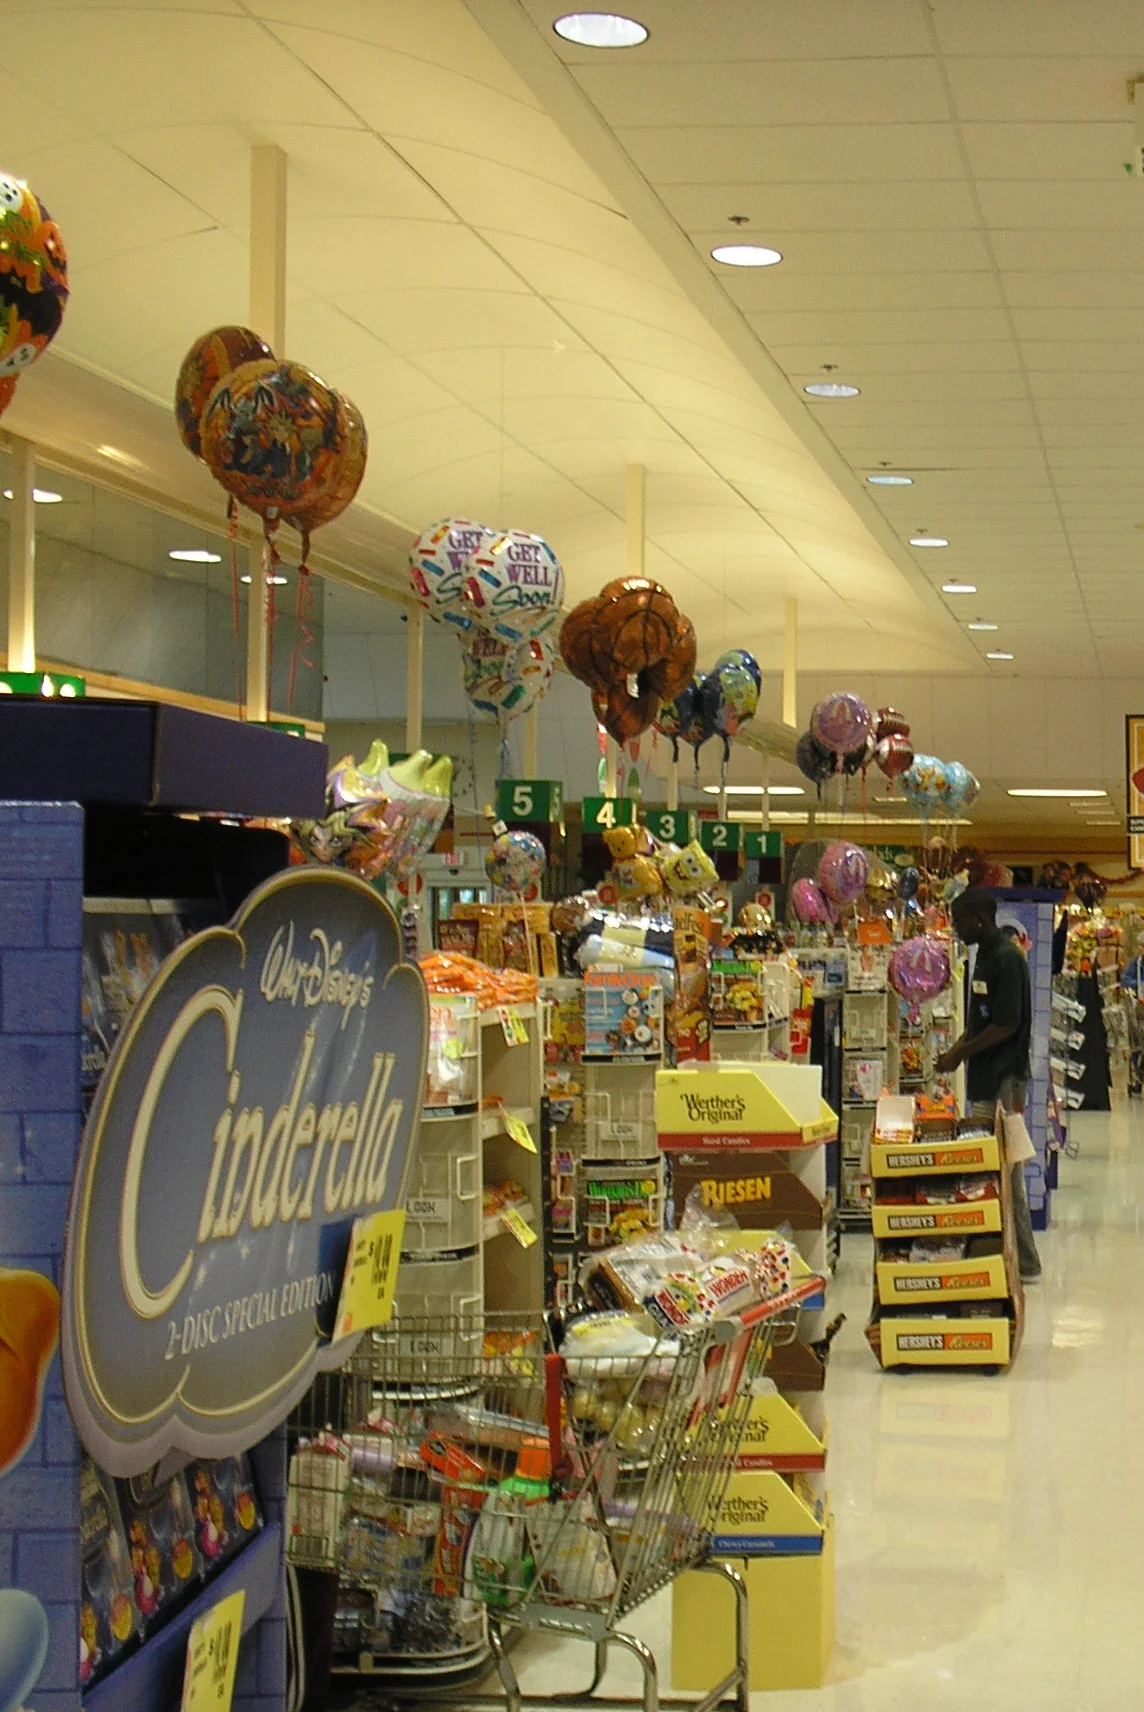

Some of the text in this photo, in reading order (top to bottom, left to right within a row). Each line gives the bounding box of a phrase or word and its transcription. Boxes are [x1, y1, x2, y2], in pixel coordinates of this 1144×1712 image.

[448, 531, 483, 550] GET
[507, 543, 541, 563] GET
[506, 564, 552, 587] WELL
[512, 787, 533, 816] 5
[596, 802, 616, 828] 4
[659, 815, 676, 838] 3
[712, 825, 728, 847] 2
[757, 835, 767, 853] 1
[680, 1093, 746, 1113] Werther's
[688, 1106, 744, 1125] Original
[119, 983, 403, 1321] Cinderella
[888, 1154, 934, 1168] HERSHEY'S
[700, 1175, 772, 1208] RIESEN
[889, 1215, 936, 1230] HERSHEY'S
[895, 1277, 941, 1290] HERSHEY'S
[164, 1270, 334, 1361] 2-DISC SPECIAL EDITION
[898, 1335, 943, 1350] HERSHEY'S
